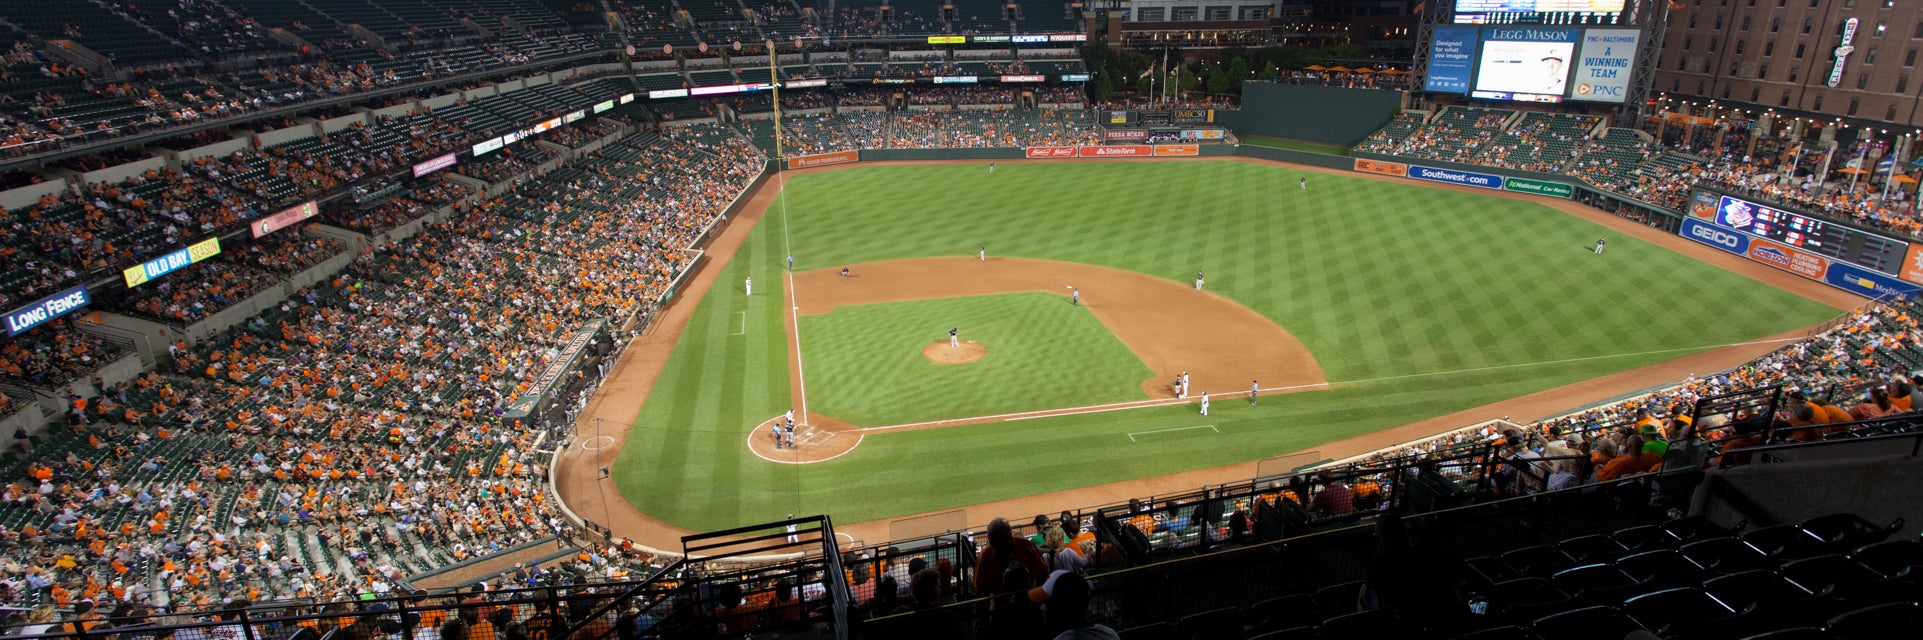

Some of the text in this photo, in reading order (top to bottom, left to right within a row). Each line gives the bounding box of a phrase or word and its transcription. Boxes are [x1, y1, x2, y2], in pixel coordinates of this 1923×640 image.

[1492, 29, 1569, 40] LEGG MASON
[1604, 47, 1611, 56] A
[1585, 57, 1628, 67] WINNING
[1591, 68, 1618, 78] TEAM
[1593, 85, 1623, 96] PNC
[1516, 181, 1542, 190] National
[1692, 224, 1738, 248] GEICO
[147, 258, 169, 277] OLD
[168, 250, 187, 269] BAY
[191, 240, 218, 260] SEASON
[1753, 248, 1790, 266] HORIZON
[1793, 252, 1819, 264] HEATING
[1790, 264, 1816, 276] COOLING
[1791, 258, 1822, 271] PLUMBING
[8, 291, 85, 332] LONG FENCE
